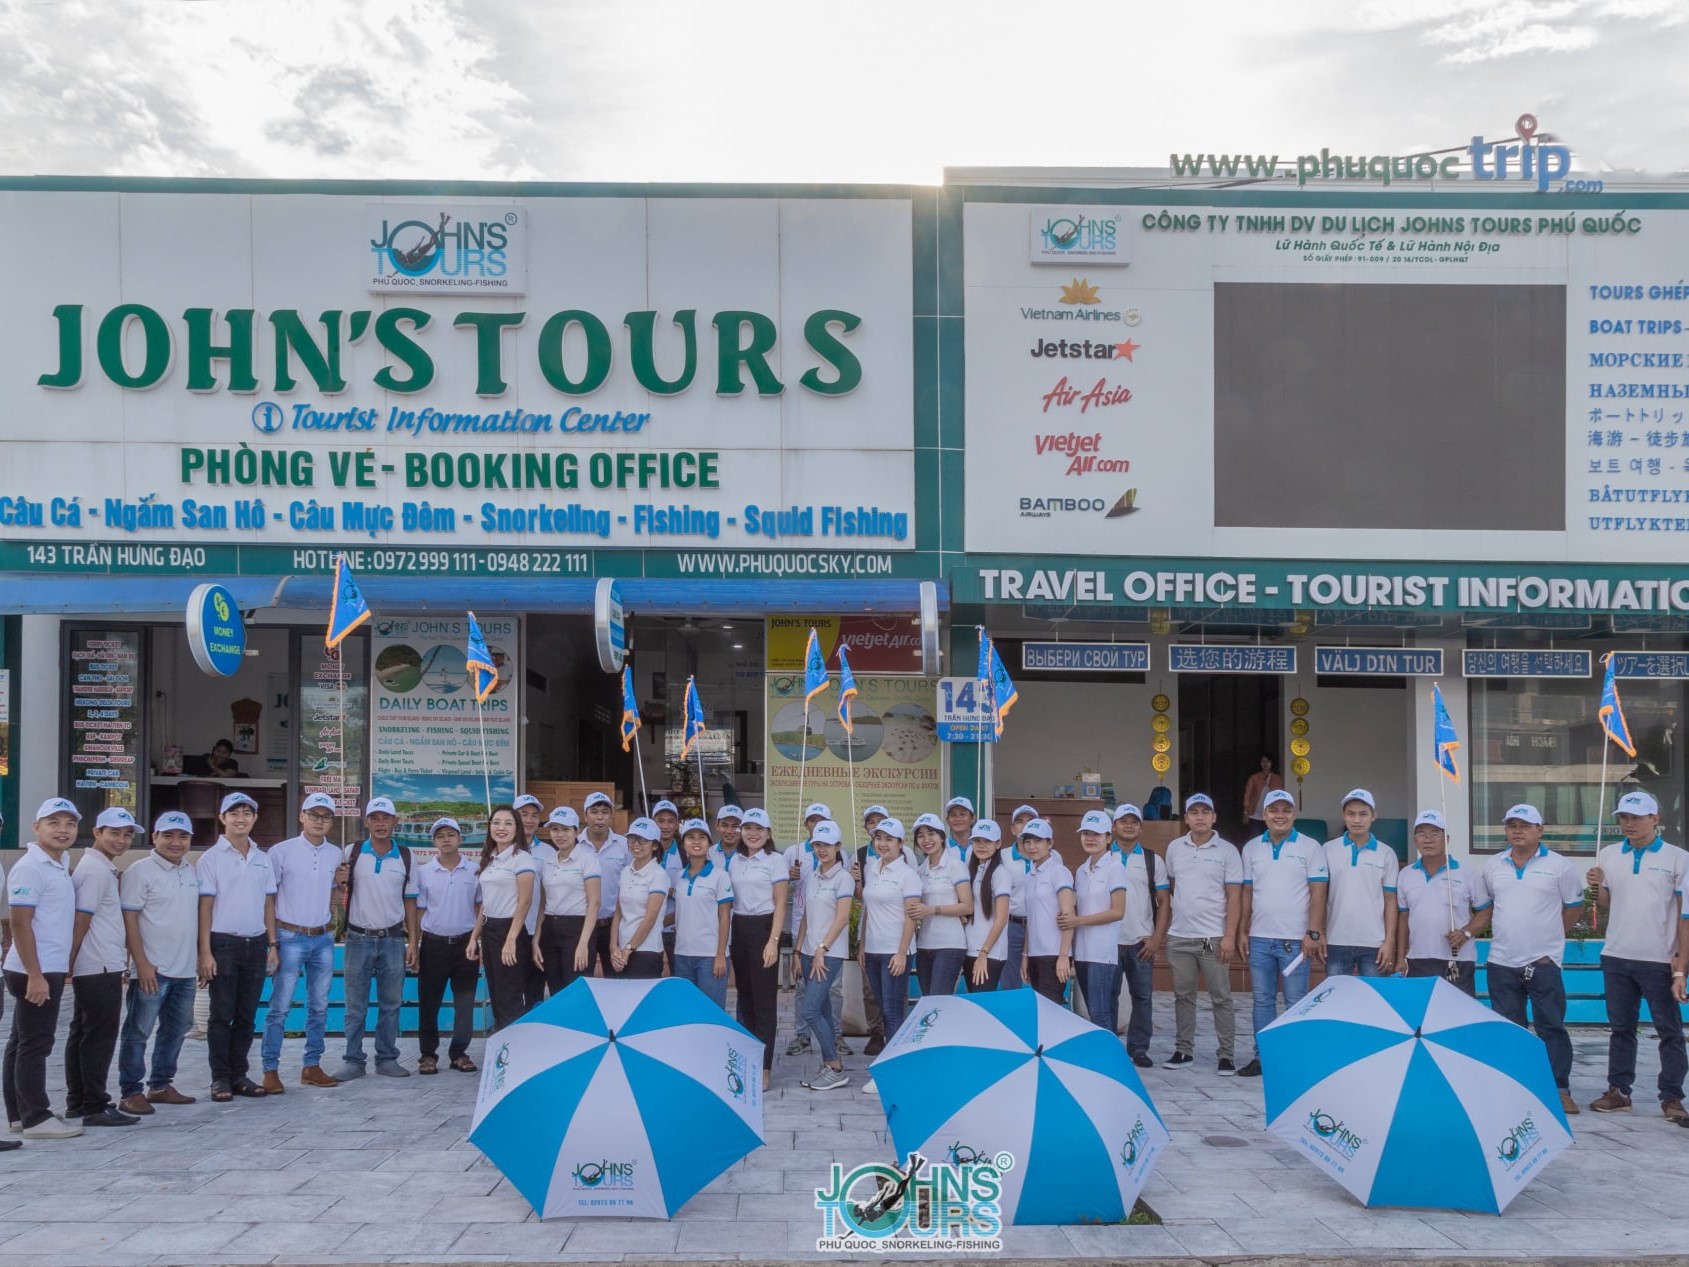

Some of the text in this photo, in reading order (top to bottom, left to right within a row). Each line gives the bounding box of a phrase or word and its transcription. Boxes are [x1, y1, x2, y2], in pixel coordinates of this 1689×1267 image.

[1142, 209, 1643, 238] CÔNG TY TNHH DV DU LỊCH JOHNS TOURS PHÚ QUỐC
[1294, 240, 1326, 251] Hành
[1330, 240, 1365, 251] Quốc
[1369, 240, 1385, 251] Tế
[1386, 241, 1396, 251] &
[1418, 240, 1450, 251] Hành
[1590, 286, 1644, 300] TOURS
[1021, 307, 1121, 321] Vietnam Airlines
[1589, 320, 1632, 334] BOAT
[37, 304, 863, 396] JOHN'S TOURS
[1030, 338, 1116, 359] Jetstar
[1589, 353, 1684, 368] МОРСКИЕ
[293, 403, 650, 437] Tourist Information Center
[181, 442, 314, 486] PHÒNG
[405, 452, 578, 489] BOOKING
[590, 451, 720, 489] OFFICE
[1020, 497, 1105, 511] BAMBOO
[0, 493, 907, 540] Câu Cá Ngắm San Hô Câu Mực Đêm Snorkeling Fishing Squid Fishing
[27, 541, 206, 570] 143 TRẦN HƯNG ĐẠO
[532, 554, 561, 572] 222
[677, 554, 892, 575] WWW.PHUQUOCSKY.COM
[979, 569, 1114, 600] TRAVEL
[1123, 570, 1257, 603] OFFICE
[1287, 573, 1449, 606] TOURIST
[1027, 647, 1146, 668] ВЫБЕРИ СВОЙ ТУР
[1176, 649, 1289, 671] 选您的游程
[1322, 650, 1436, 673] VÄLJ DIN TUR
[1468, 652, 1496, 674] 당신의
[1501, 652, 1529, 675] 여행을
[379, 697, 421, 710] DAILY
[427, 698, 466, 710] BOAT
[863, 767, 938, 780] ЭКСКУРСИИ
